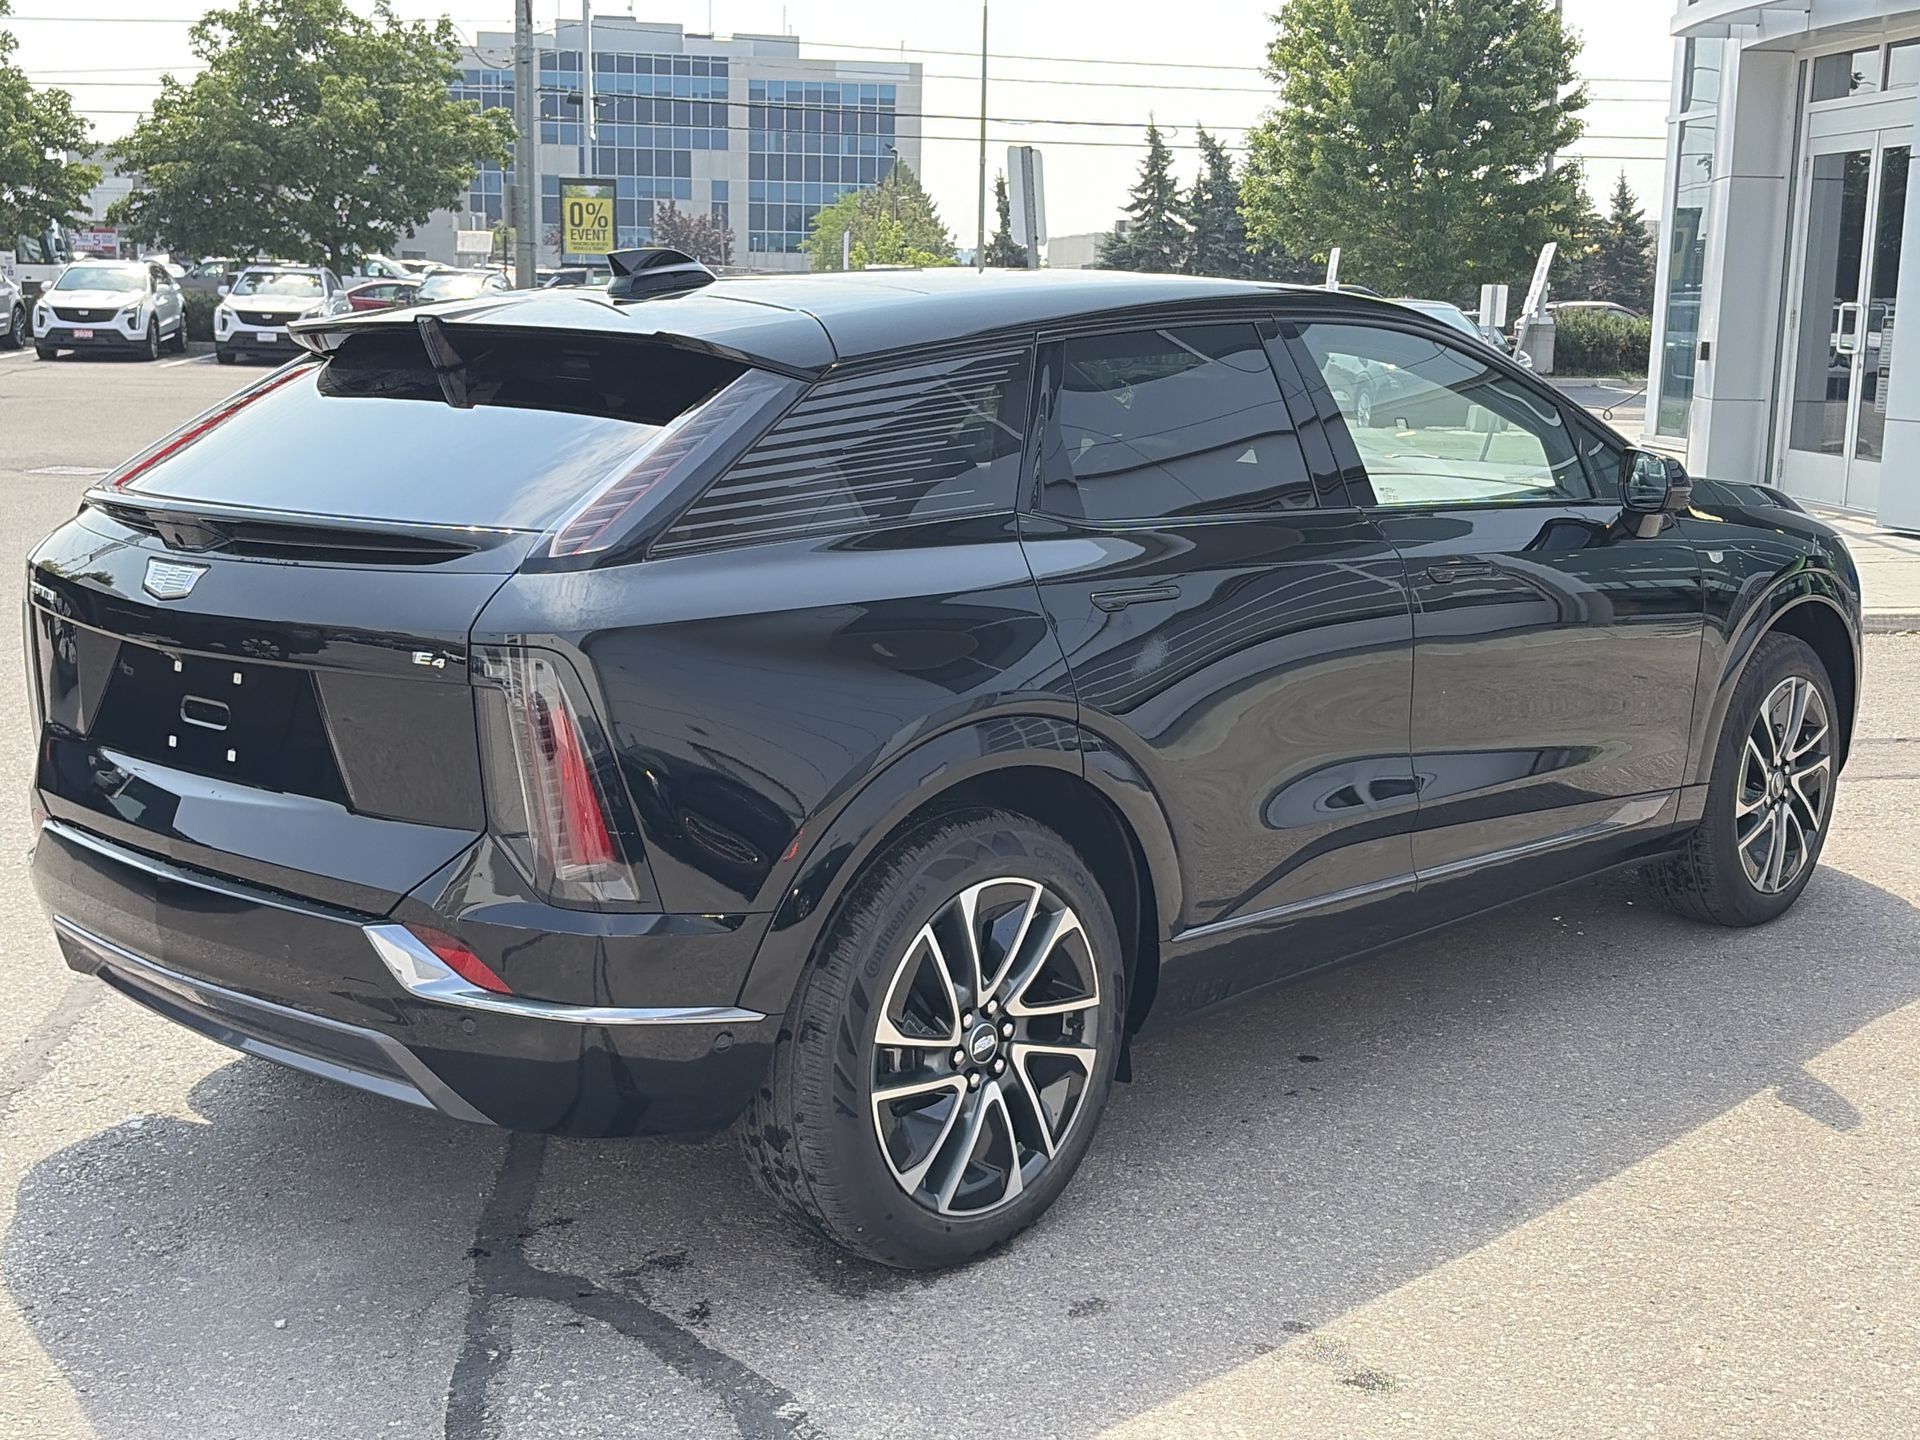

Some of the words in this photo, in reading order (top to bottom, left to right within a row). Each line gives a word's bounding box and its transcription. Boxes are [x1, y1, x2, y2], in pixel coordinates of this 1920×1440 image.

[569, 201, 609, 229] 0%
[570, 228, 608, 241] EVENT
[412, 651, 446, 669] E4
[863, 889, 922, 978] Continental
